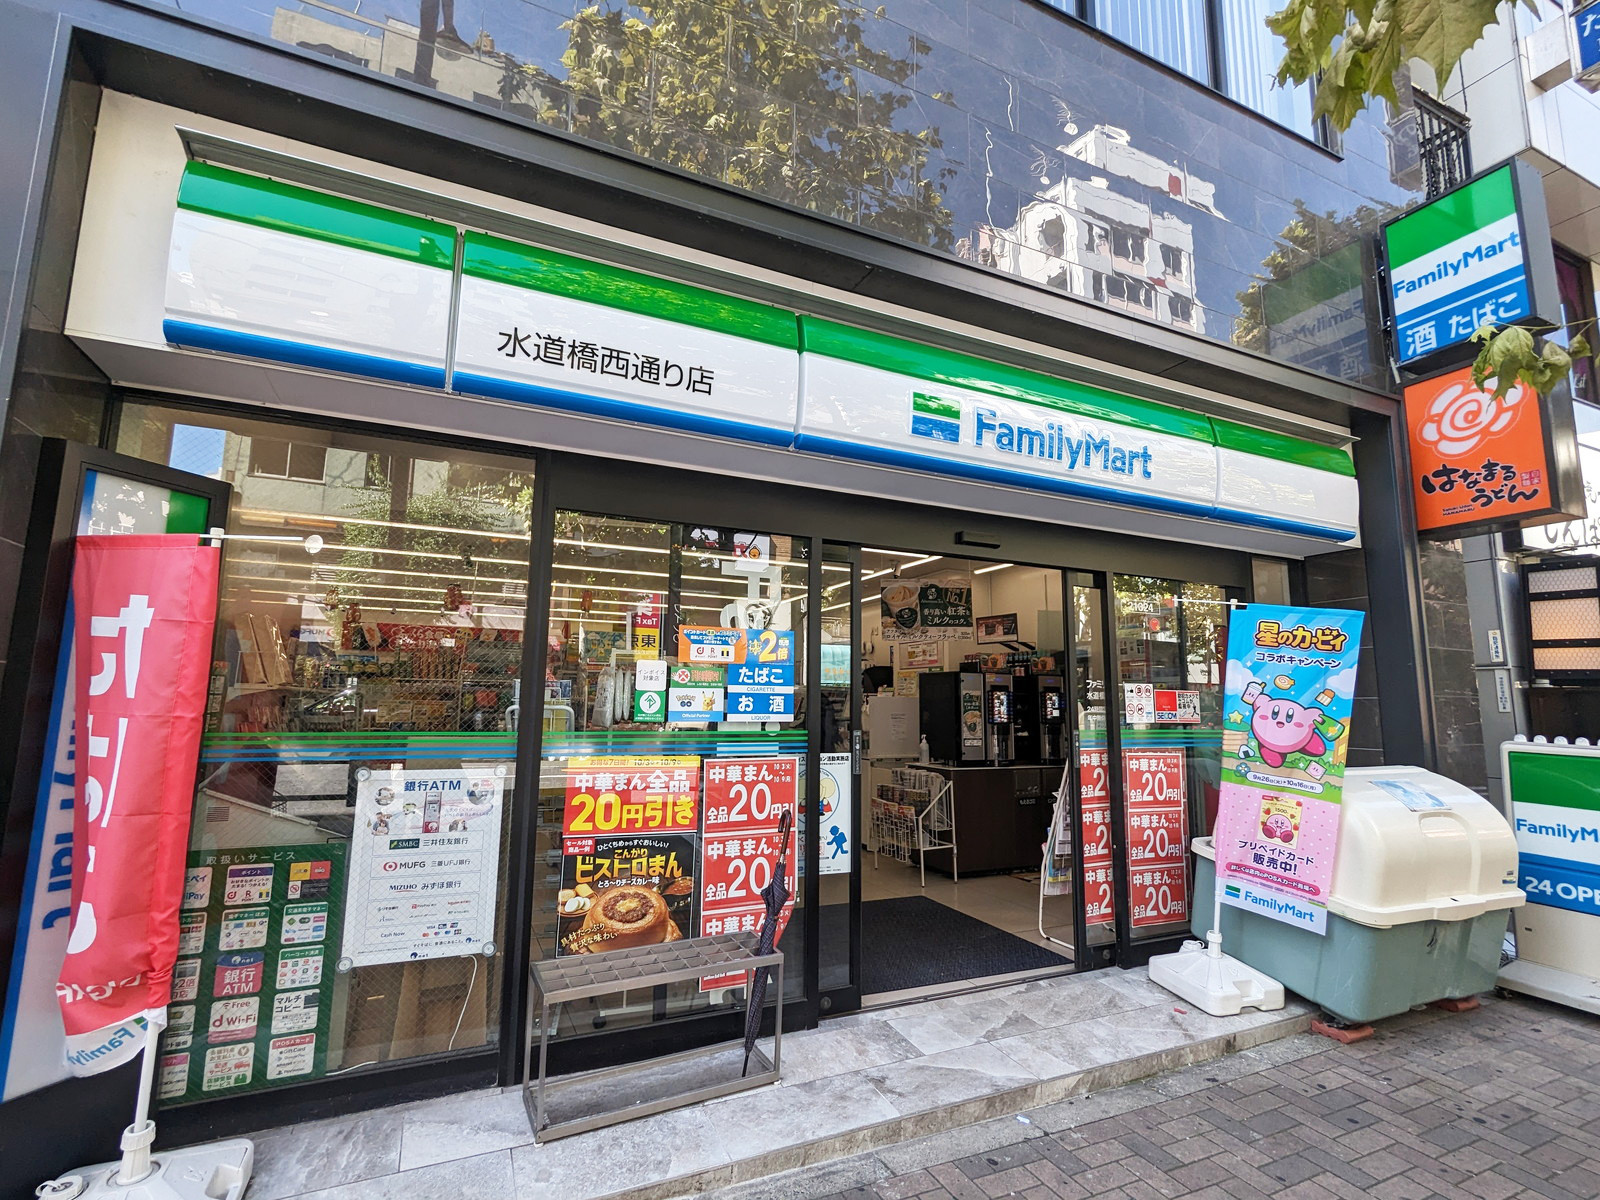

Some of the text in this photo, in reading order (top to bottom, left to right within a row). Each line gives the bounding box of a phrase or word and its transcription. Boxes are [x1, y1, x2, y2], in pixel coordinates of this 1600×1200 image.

[1393, 231, 1519, 299] FamilyMart
[1406, 292, 1521, 356] 酒 たばこ
[497, 326, 715, 396] 水道橋西通り店
[974, 406, 1152, 479] FamilyMart
[1421, 459, 1516, 494] はなまる
[1471, 483, 1539, 508] うどん
[759, 630, 777, 662] 2
[1254, 620, 1348, 653] 星のカービィ
[1255, 652, 1341, 668] コラボキャンペーン
[739, 667, 783, 684] たばこ
[709, 764, 773, 784] 中華まん
[1129, 758, 1167, 772] 中華まん
[404, 780, 461, 792] 銀行ATM
[575, 769, 690, 793] 中華まん全品
[1130, 772, 1180, 802] 全品20円引
[569, 793, 695, 832] 20円引き
[1130, 814, 1169, 828] 中華まん
[422, 837, 468, 847] 三井住友銀行
[707, 837, 773, 860] 中華まん
[1131, 829, 1182, 859] 全品20円引
[1238, 840, 1315, 865] プリペイドカード
[206, 851, 296, 865] 取扱いサービス
[400, 859, 471, 870] MUFG 三菱UFJ銀行
[614, 848, 648, 859] こんがり
[1252, 853, 1297, 875] 販売中!
[576, 851, 682, 883] ビストロまん
[421, 881, 461, 890] みずほ銀行
[705, 856, 793, 902] 全品20引
[1133, 871, 1171, 886] 中華まん
[1525, 876, 1554, 896] 24
[1133, 886, 1185, 919] 全品20円引
[1244, 891, 1314, 922] FamilyMart
[561, 922, 605, 947] 具材たっぷり
[223, 968, 256, 984] 銀行
[222, 984, 254, 995] ATM
[275, 995, 302, 1003] マルチ
[226, 1015, 256, 1025] Wi-Fi
[275, 1037, 311, 1046] POSAカード
